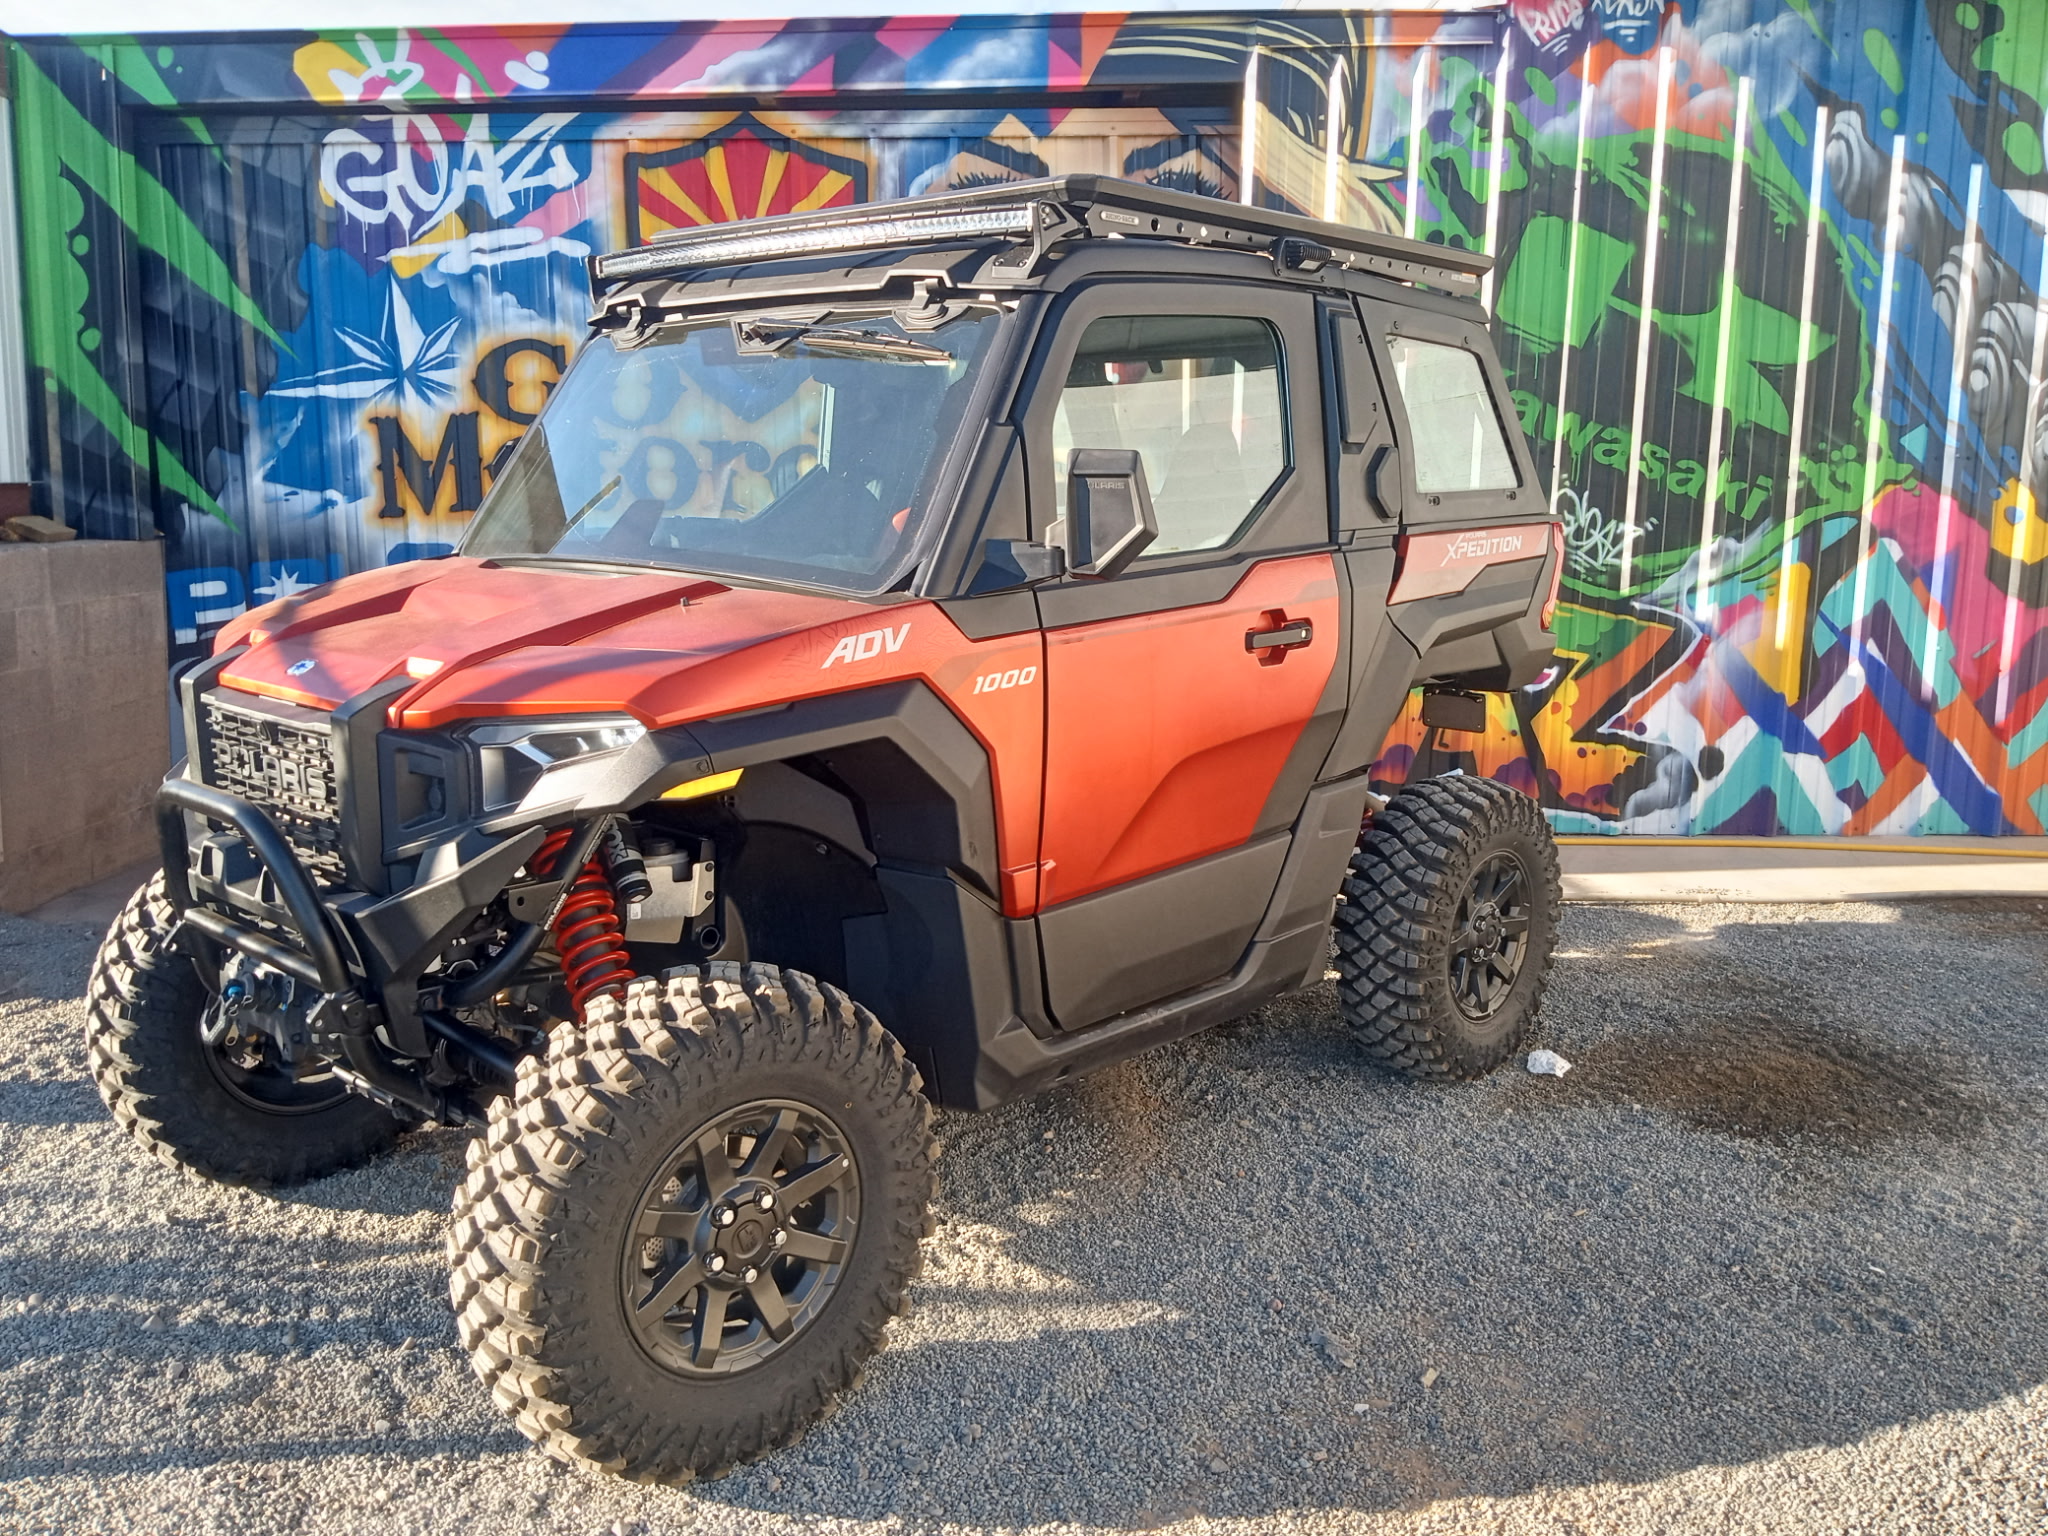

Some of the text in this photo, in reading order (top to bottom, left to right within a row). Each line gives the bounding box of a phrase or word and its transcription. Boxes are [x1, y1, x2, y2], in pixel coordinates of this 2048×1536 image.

[1509, 388, 1773, 521] awasaki
[1440, 534, 1522, 567] XPEDITION
[821, 623, 911, 669] ADV
[973, 666, 1037, 695] 1000
[213, 740, 327, 802] POLARIS
